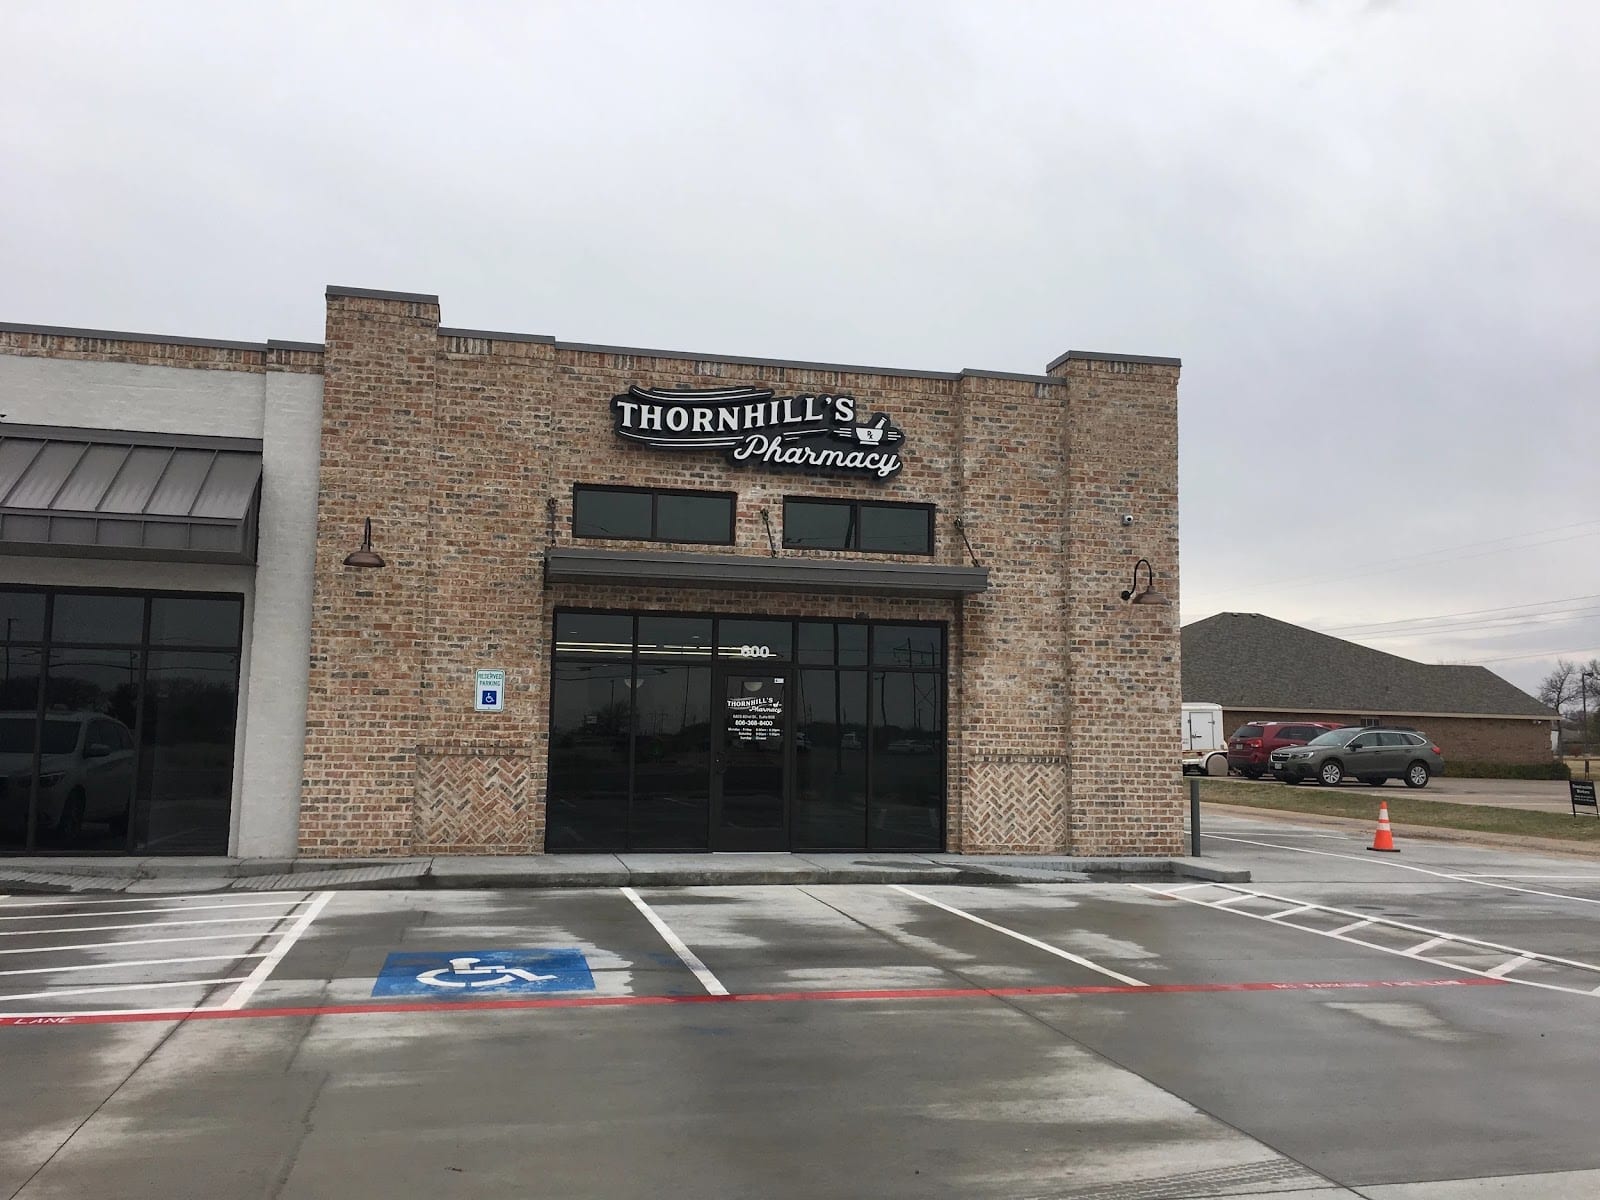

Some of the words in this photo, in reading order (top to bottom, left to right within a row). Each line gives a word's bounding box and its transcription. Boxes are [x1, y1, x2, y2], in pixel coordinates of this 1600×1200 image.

[617, 397, 854, 431] THORNHILL'S
[733, 434, 901, 476] Pharmacy
[727, 697, 773, 706] THORNHILL'S
[749, 705, 782, 713] Pharmacy
[14, 1016, 76, 1025] LANE
